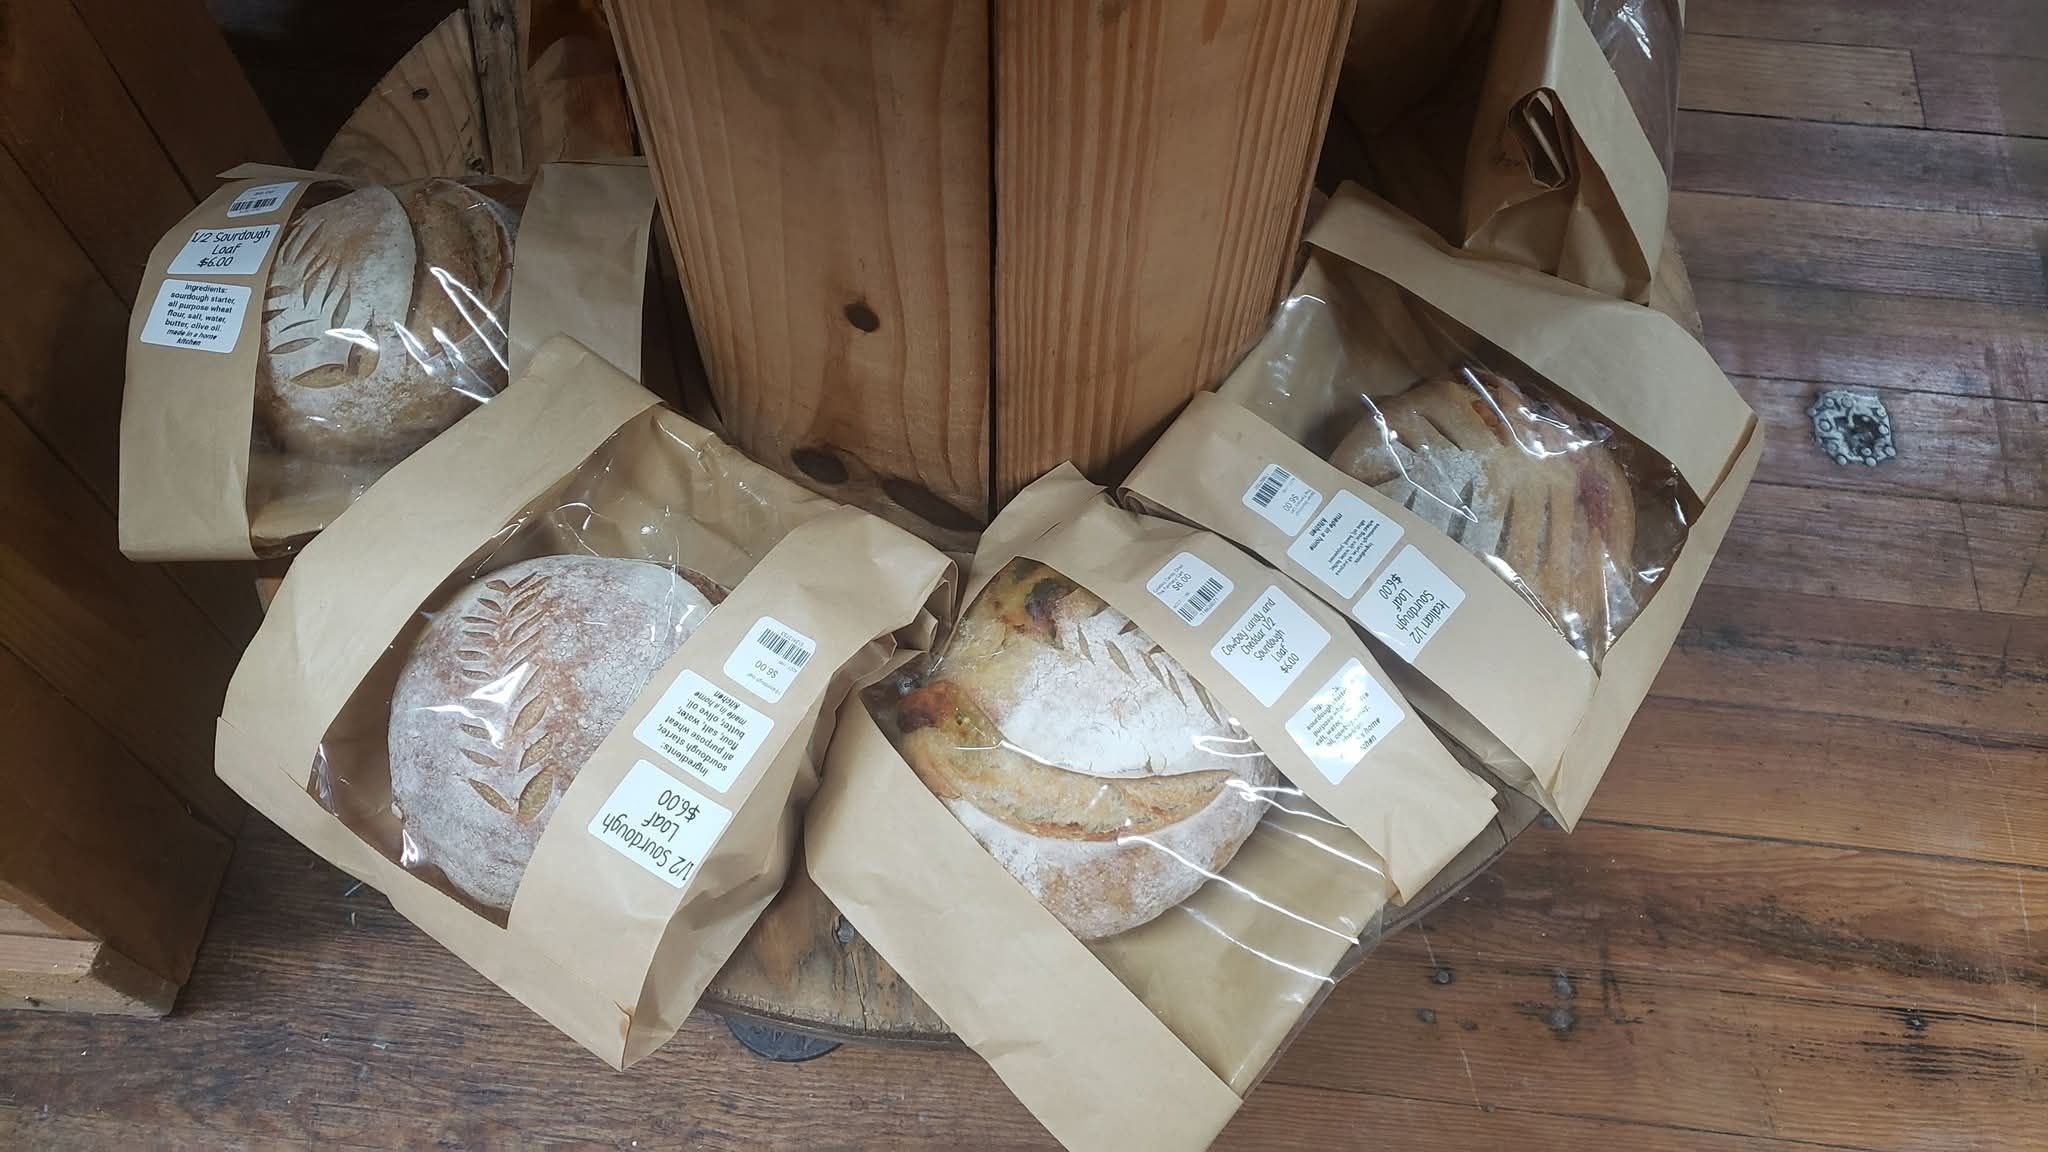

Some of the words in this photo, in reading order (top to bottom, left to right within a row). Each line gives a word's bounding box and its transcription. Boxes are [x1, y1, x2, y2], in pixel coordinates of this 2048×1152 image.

[191, 232, 213, 243] 1/2
[213, 227, 271, 245] Sourdough
[211, 243, 243, 255] Loaf
[197, 256, 234, 268] $6.00
[167, 300, 179, 308] all
[178, 303, 209, 311] purpose
[210, 305, 233, 313] wheat
[170, 292, 209, 303] sourdough
[211, 296, 235, 305] starter,
[164, 318, 189, 329] butter,
[190, 322, 209, 330] olive
[167, 309, 186, 319] flour,
[187, 313, 203, 321] salt,
[205, 316, 226, 324] water,
[176, 337, 201, 346] kitchen
[198, 332, 217, 340] home
[1309, 517, 1328, 537] kitchen
[1329, 512, 1343, 529] made
[1309, 536, 1324, 551] home
[1172, 573, 1192, 591] $6.00
[1378, 573, 1403, 600] $6.00
[1391, 588, 1414, 613] Loaf
[1395, 590, 1435, 631] Sourdough
[1420, 599, 1450, 628] Italian
[1221, 629, 1251, 656] Cowboy
[1244, 611, 1268, 634] candy
[1262, 597, 1276, 614] and
[1240, 628, 1266, 655] Cheddar
[1261, 616, 1277, 631] 1/2
[1409, 626, 1427, 644] 1/2
[1253, 629, 1286, 661] Sourdough
[1271, 642, 1288, 662] Loaf
[754, 660, 779, 679] $6.00
[1280, 653, 1300, 674] $6.00
[686, 698, 699, 710] oil.
[694, 691, 715, 707] home
[713, 691, 740, 710] kitchen
[676, 706, 700, 726] water,
[699, 707, 719, 722] olive
[719, 706, 728, 715] in
[726, 711, 747, 726] made
[657, 723, 686, 745] starter,
[664, 716, 690, 734] wheat
[701, 721, 718, 736] salt,
[720, 718, 745, 740] butter,
[1363, 717, 1381, 734] home
[690, 731, 725, 754] purpose
[719, 732, 739, 751] flour,
[685, 743, 728, 772] sourdough
[721, 751, 734, 761] all
[657, 790, 700, 823] $6.00
[641, 811, 680, 842] Loaf
[602, 813, 672, 867] Sourdough
[668, 856, 694, 881] 1/2
